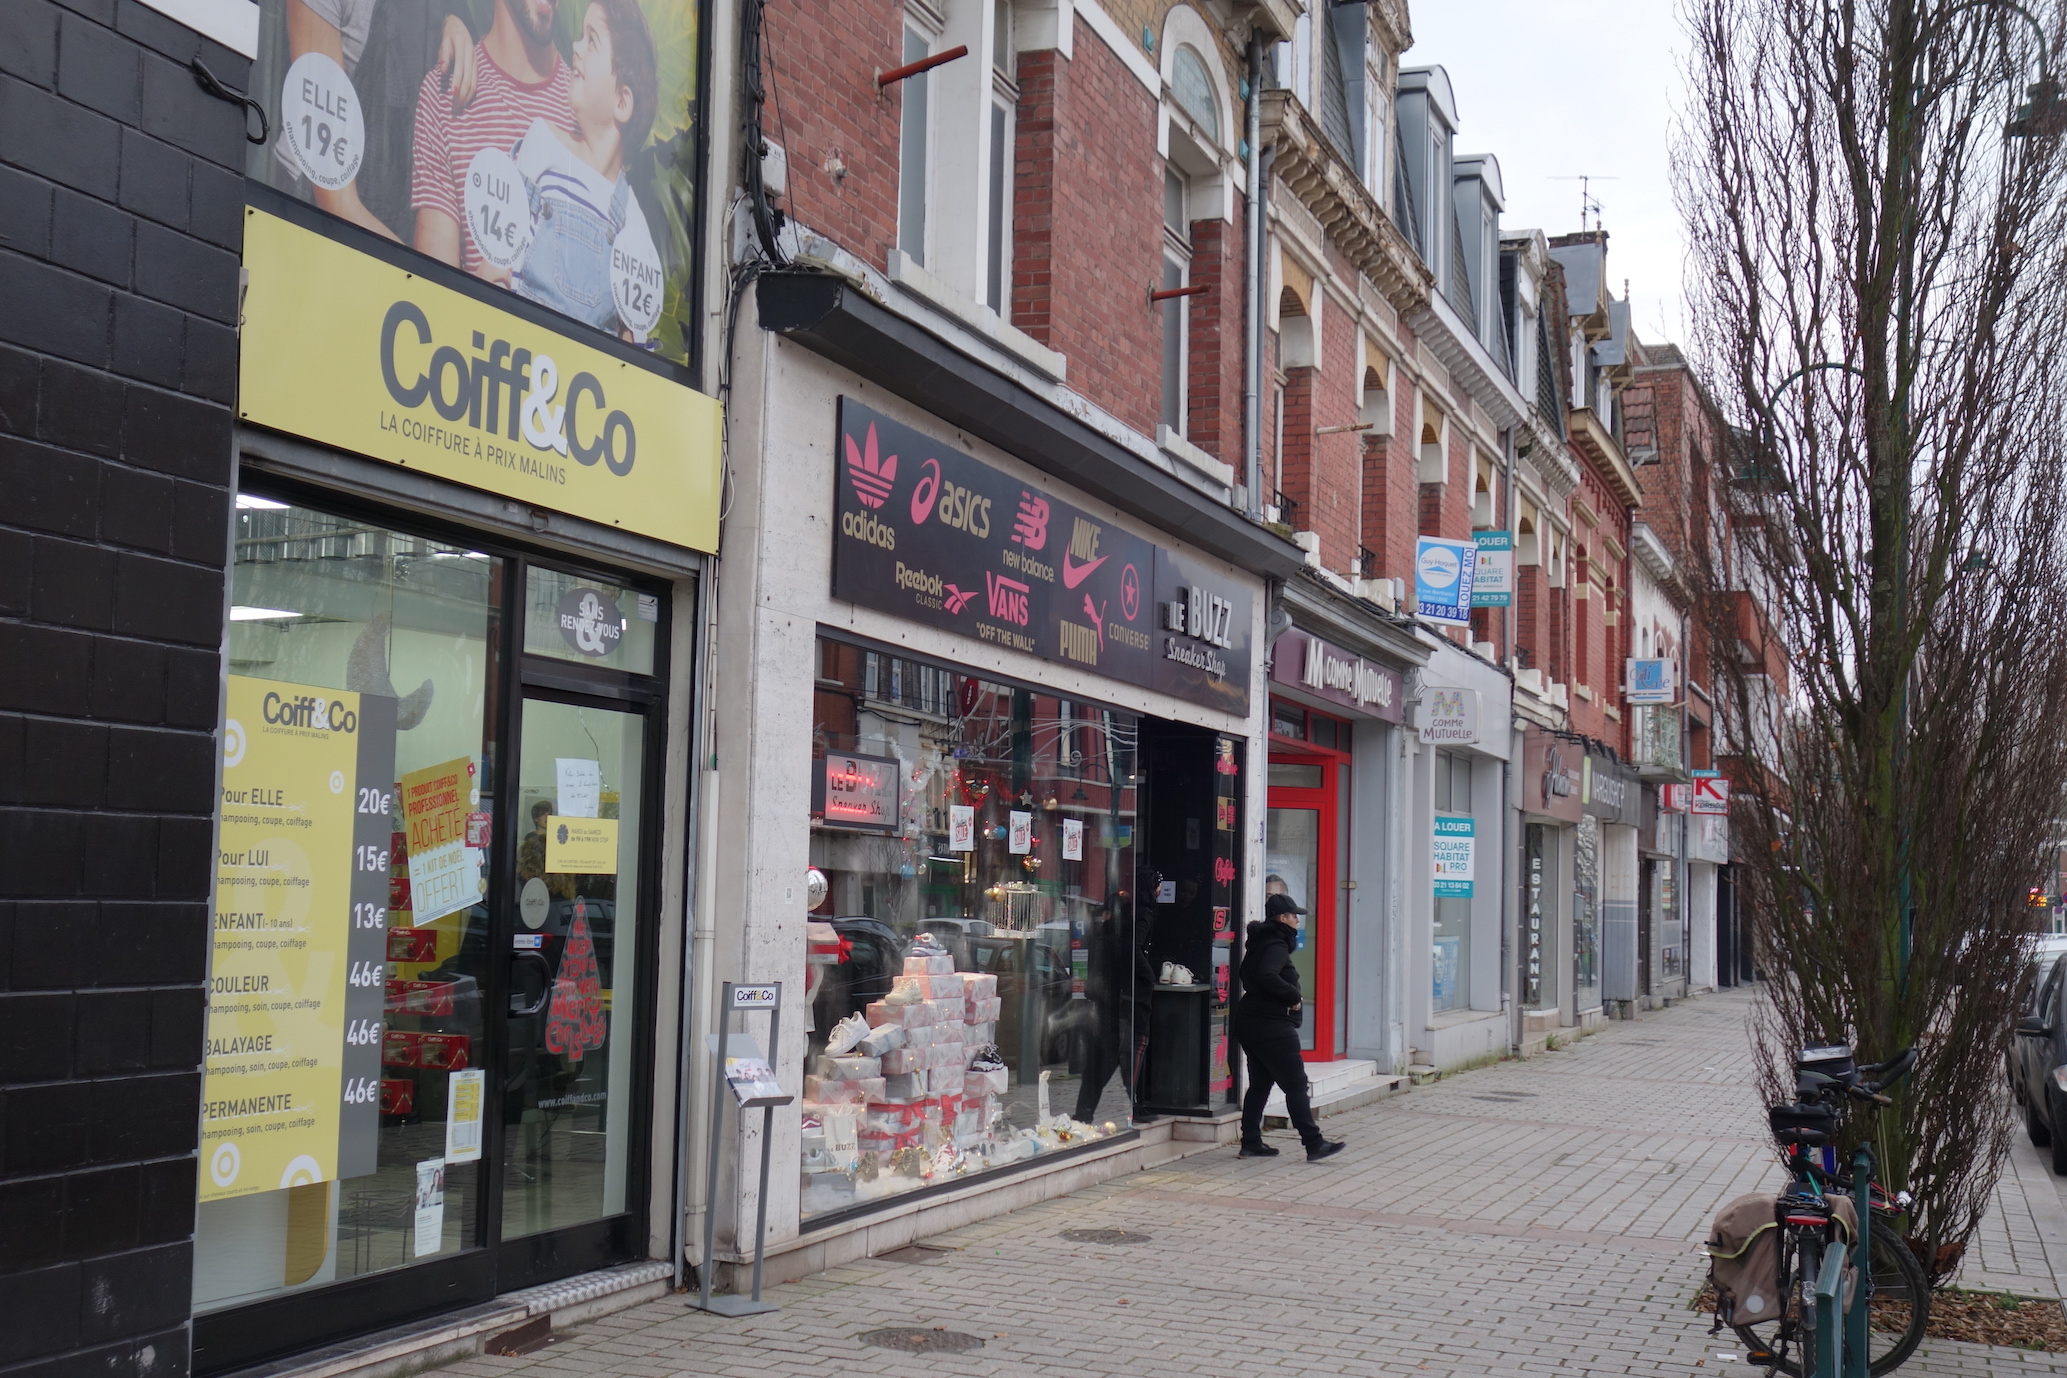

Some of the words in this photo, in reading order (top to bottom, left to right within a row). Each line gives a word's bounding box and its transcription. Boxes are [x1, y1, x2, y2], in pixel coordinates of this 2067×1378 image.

[302, 77, 347, 122] ELLE
[302, 114, 348, 166] 19€
[286, 121, 317, 180] shampooing,
[318, 174, 340, 187] coupe,
[340, 154, 359, 181] coiffage
[487, 173, 510, 205] LUI
[468, 210, 493, 261] shampooing,
[494, 256, 511, 267] coupe,
[511, 236, 526, 262] coiffage
[480, 204, 517, 248] 14€
[614, 248, 661, 289] ENFANT
[622, 278, 653, 317] 12€
[380, 300, 636, 477] Coiff&Co
[380, 410, 398, 434] LA
[402, 418, 470, 456] COIFFURE
[474, 436, 483, 460] À
[486, 444, 516, 471] PRIX
[520, 455, 566, 485] MALINS
[842, 509, 896, 551] adidas
[1070, 516, 1102, 563] NIKE
[1002, 549, 1021, 568] new
[1421, 557, 1433, 566] Guy
[1434, 559, 1458, 568] Hoquet
[1464, 547, 1475, 568] MOI
[895, 560, 944, 598] Reebok
[1460, 570, 1472, 608] LOUEZ
[578, 602, 604, 620] SANS
[915, 593, 943, 611] CLASSIC
[986, 570, 1030, 627] VANS
[1417, 602, 1424, 613] 3
[1426, 604, 1435, 615] 21
[1436, 605, 1446, 616] 20
[1447, 606, 1457, 618] 39
[1459, 609, 1468, 620] 18
[561, 614, 620, 640] RENDEZ-VOUS
[1169, 601, 1185, 633] LE
[1189, 586, 1233, 650] BUZZ
[996, 629, 1012, 645] THE
[1060, 620, 1098, 666] PUMA
[1109, 622, 1149, 651] CONVERSE
[1168, 637, 1206, 670] Sneaker
[1206, 651, 1226, 684] Shop
[1304, 638, 1324, 690] M
[262, 692, 357, 734] Coiff&Co
[1430, 692, 1465, 717] M
[270, 727, 294, 736] COIFFURE
[300, 730, 310, 738] PRIX
[311, 732, 329, 740] MALINS
[407, 788, 411, 797] 1
[411, 780, 433, 796] PRODUIT
[433, 774, 458, 792] COIFF&CO
[832, 773, 844, 791] LE
[252, 788, 283, 806] ELLE
[358, 788, 391, 815] 20€
[408, 788, 460, 818] PROFESSIONNEL
[220, 814, 261, 826] hampooing,
[262, 818, 285, 827] coupe,
[286, 816, 313, 829] coiffage
[412, 804, 463, 852] ACHETÉ
[1434, 822, 1441, 831] A
[1442, 822, 1471, 832] LOUER
[248, 850, 269, 866] LUI
[356, 845, 388, 872] 15€
[1434, 842, 1471, 852] SQUARE
[1434, 852, 1470, 862] HABITAT
[422, 863, 426, 875] 1
[427, 858, 437, 874] KIT
[439, 855, 447, 871] DE
[448, 848, 465, 867] NOËL
[1450, 862, 1468, 871] PRO
[216, 876, 258, 887] hampooing,
[259, 877, 282, 887] coupe,
[283, 876, 310, 889] coiffage
[416, 866, 469, 913] OFFERT
[214, 912, 263, 930] ENFANT
[354, 902, 386, 929] 13€
[213, 939, 254, 951] hampooing,
[256, 940, 278, 950] coupe,
[280, 938, 307, 949] coiffage
[210, 975, 269, 994] COULEUR
[350, 961, 383, 987] 46€
[209, 1003, 251, 1015] hampooing,
[252, 1002, 270, 1012] soin,
[271, 1001, 294, 1012] coupe,
[294, 1000, 321, 1010] coiffage
[737, 990, 774, 1001] Coiff&Co
[206, 1034, 273, 1056] BALAYAGE
[346, 1018, 381, 1046] 46€
[206, 1062, 248, 1077] hampooing,
[250, 1061, 267, 1072] soin,
[268, 1060, 290, 1071] coupe,
[292, 1058, 318, 1069] coiffage
[344, 1077, 378, 1105] 46€
[538, 1090, 607, 1109] www.coiffandco.com
[202, 1093, 292, 1119] PERMANENTE
[202, 1126, 245, 1140] hampooing,
[246, 1123, 263, 1134] soin,
[264, 1120, 288, 1132] coupe,
[288, 1118, 316, 1129] coiffage
[835, 1143, 856, 1152] BUZZ
